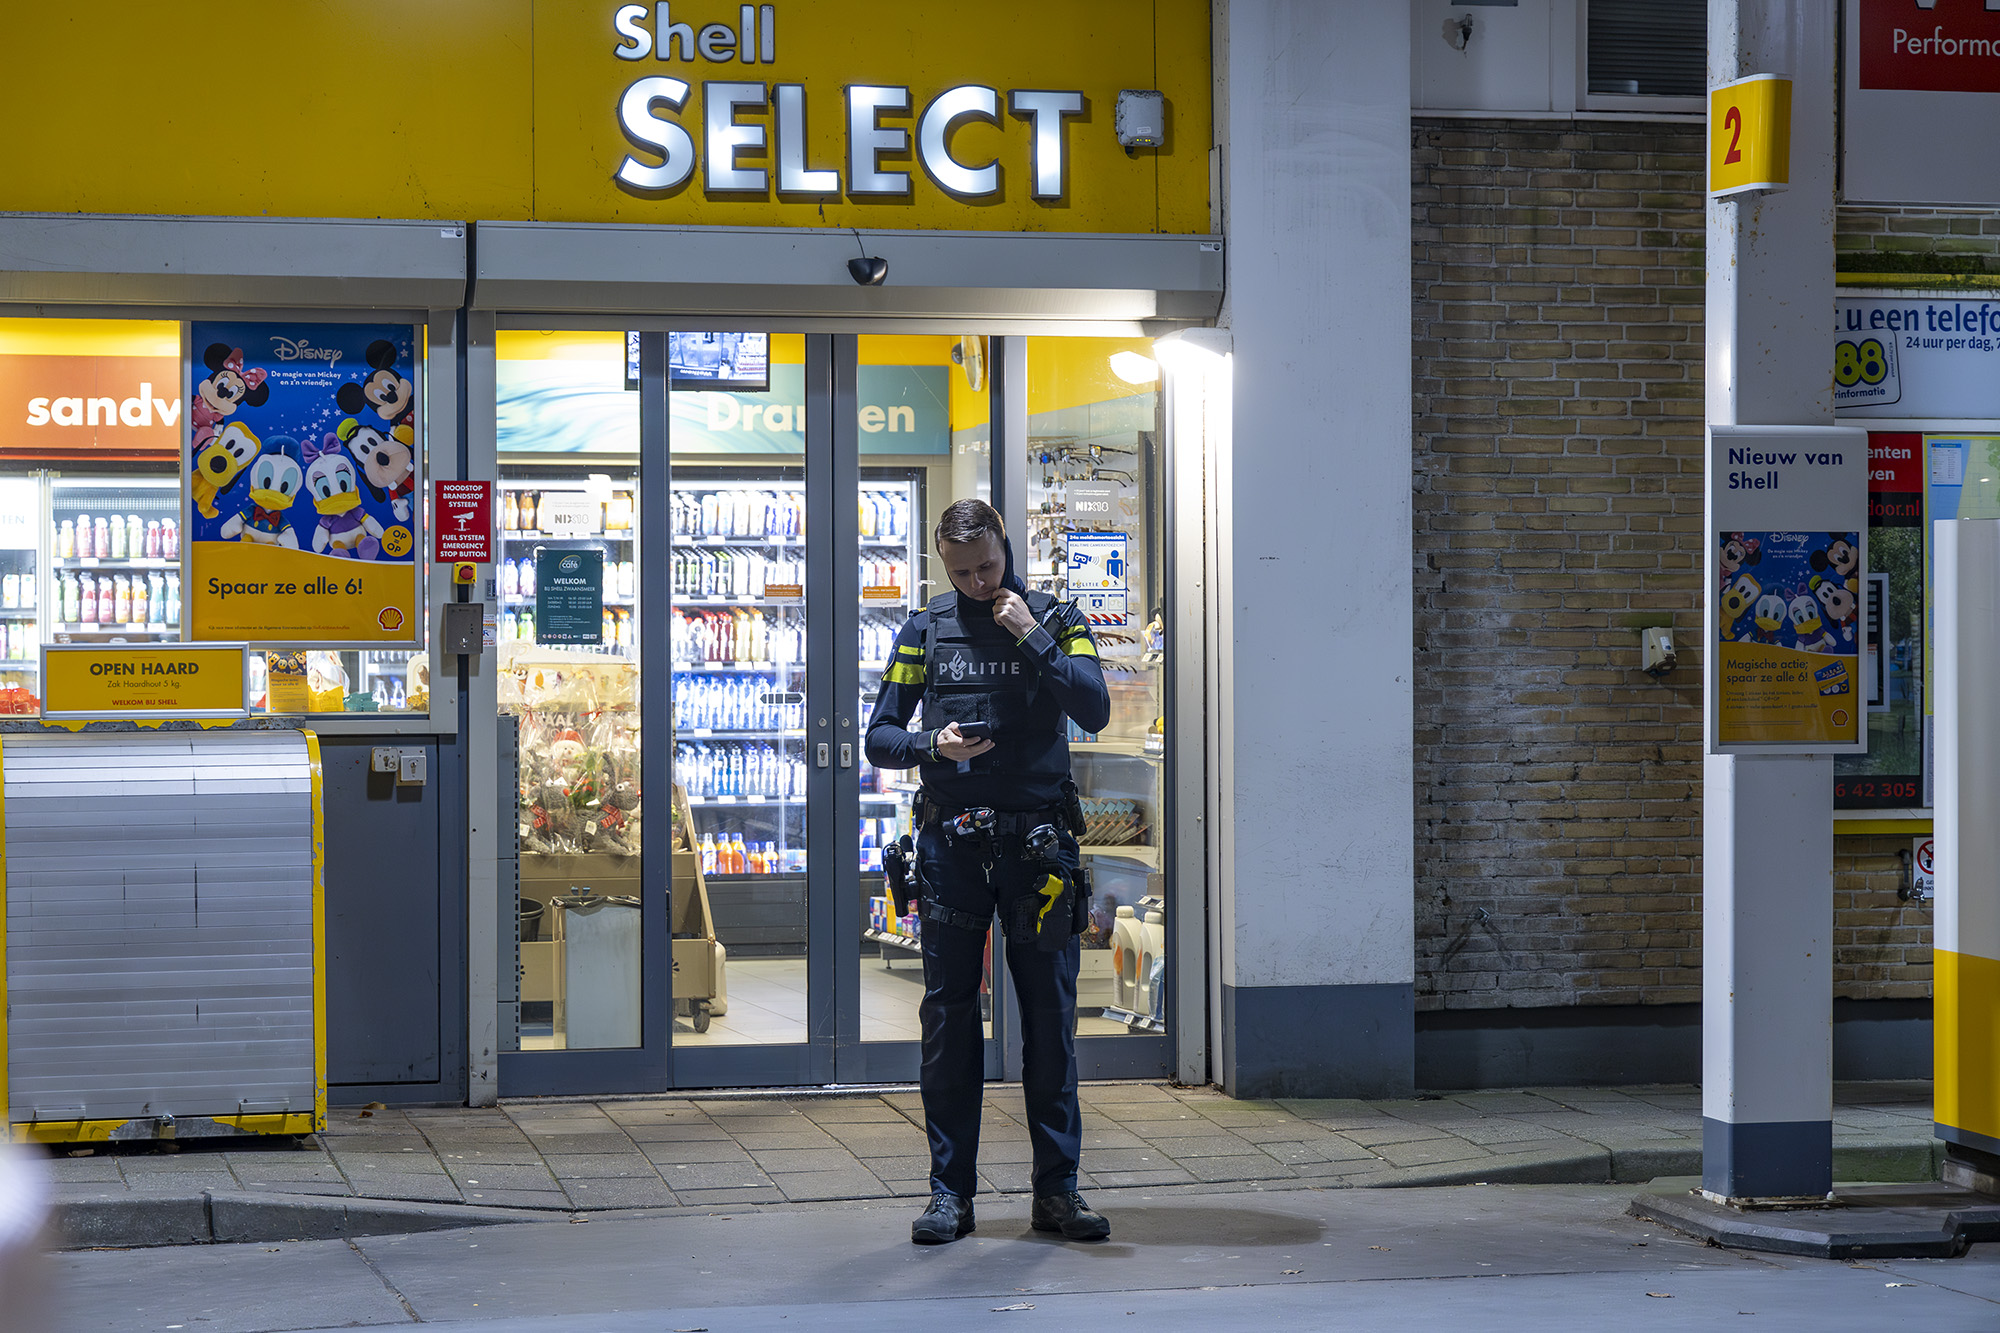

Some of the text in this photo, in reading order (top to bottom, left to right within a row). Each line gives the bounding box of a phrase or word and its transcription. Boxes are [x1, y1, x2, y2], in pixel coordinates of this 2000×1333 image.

[613, 0, 775, 64] Shell
[614, 75, 1084, 199] SELECT
[1724, 106, 1742, 165] 2
[1846, 309, 1862, 330] u
[1870, 309, 1918, 332] een
[1906, 336, 1920, 348] 24
[1922, 338, 1944, 349] uur
[1946, 338, 1966, 351] per
[1968, 336, 1994, 352] dag,
[269, 336, 343, 369] Disney
[317, 371, 341, 380] Mickey
[1728, 447, 1843, 465] Nieuw van
[1728, 471, 1779, 490] Shell
[393, 530, 407, 540] OP
[387, 542, 401, 552] OP
[208, 576, 362, 599] Spaar ze alle 6!
[90, 662, 199, 676] OPEN HAARD
[1727, 658, 1777, 672] Magische
[171, 680, 181, 689] kg.
[1726, 671, 1808, 685] spaar ze alle 6!
[1852, 783, 1876, 797] 42
[1881, 783, 1916, 797] 305
